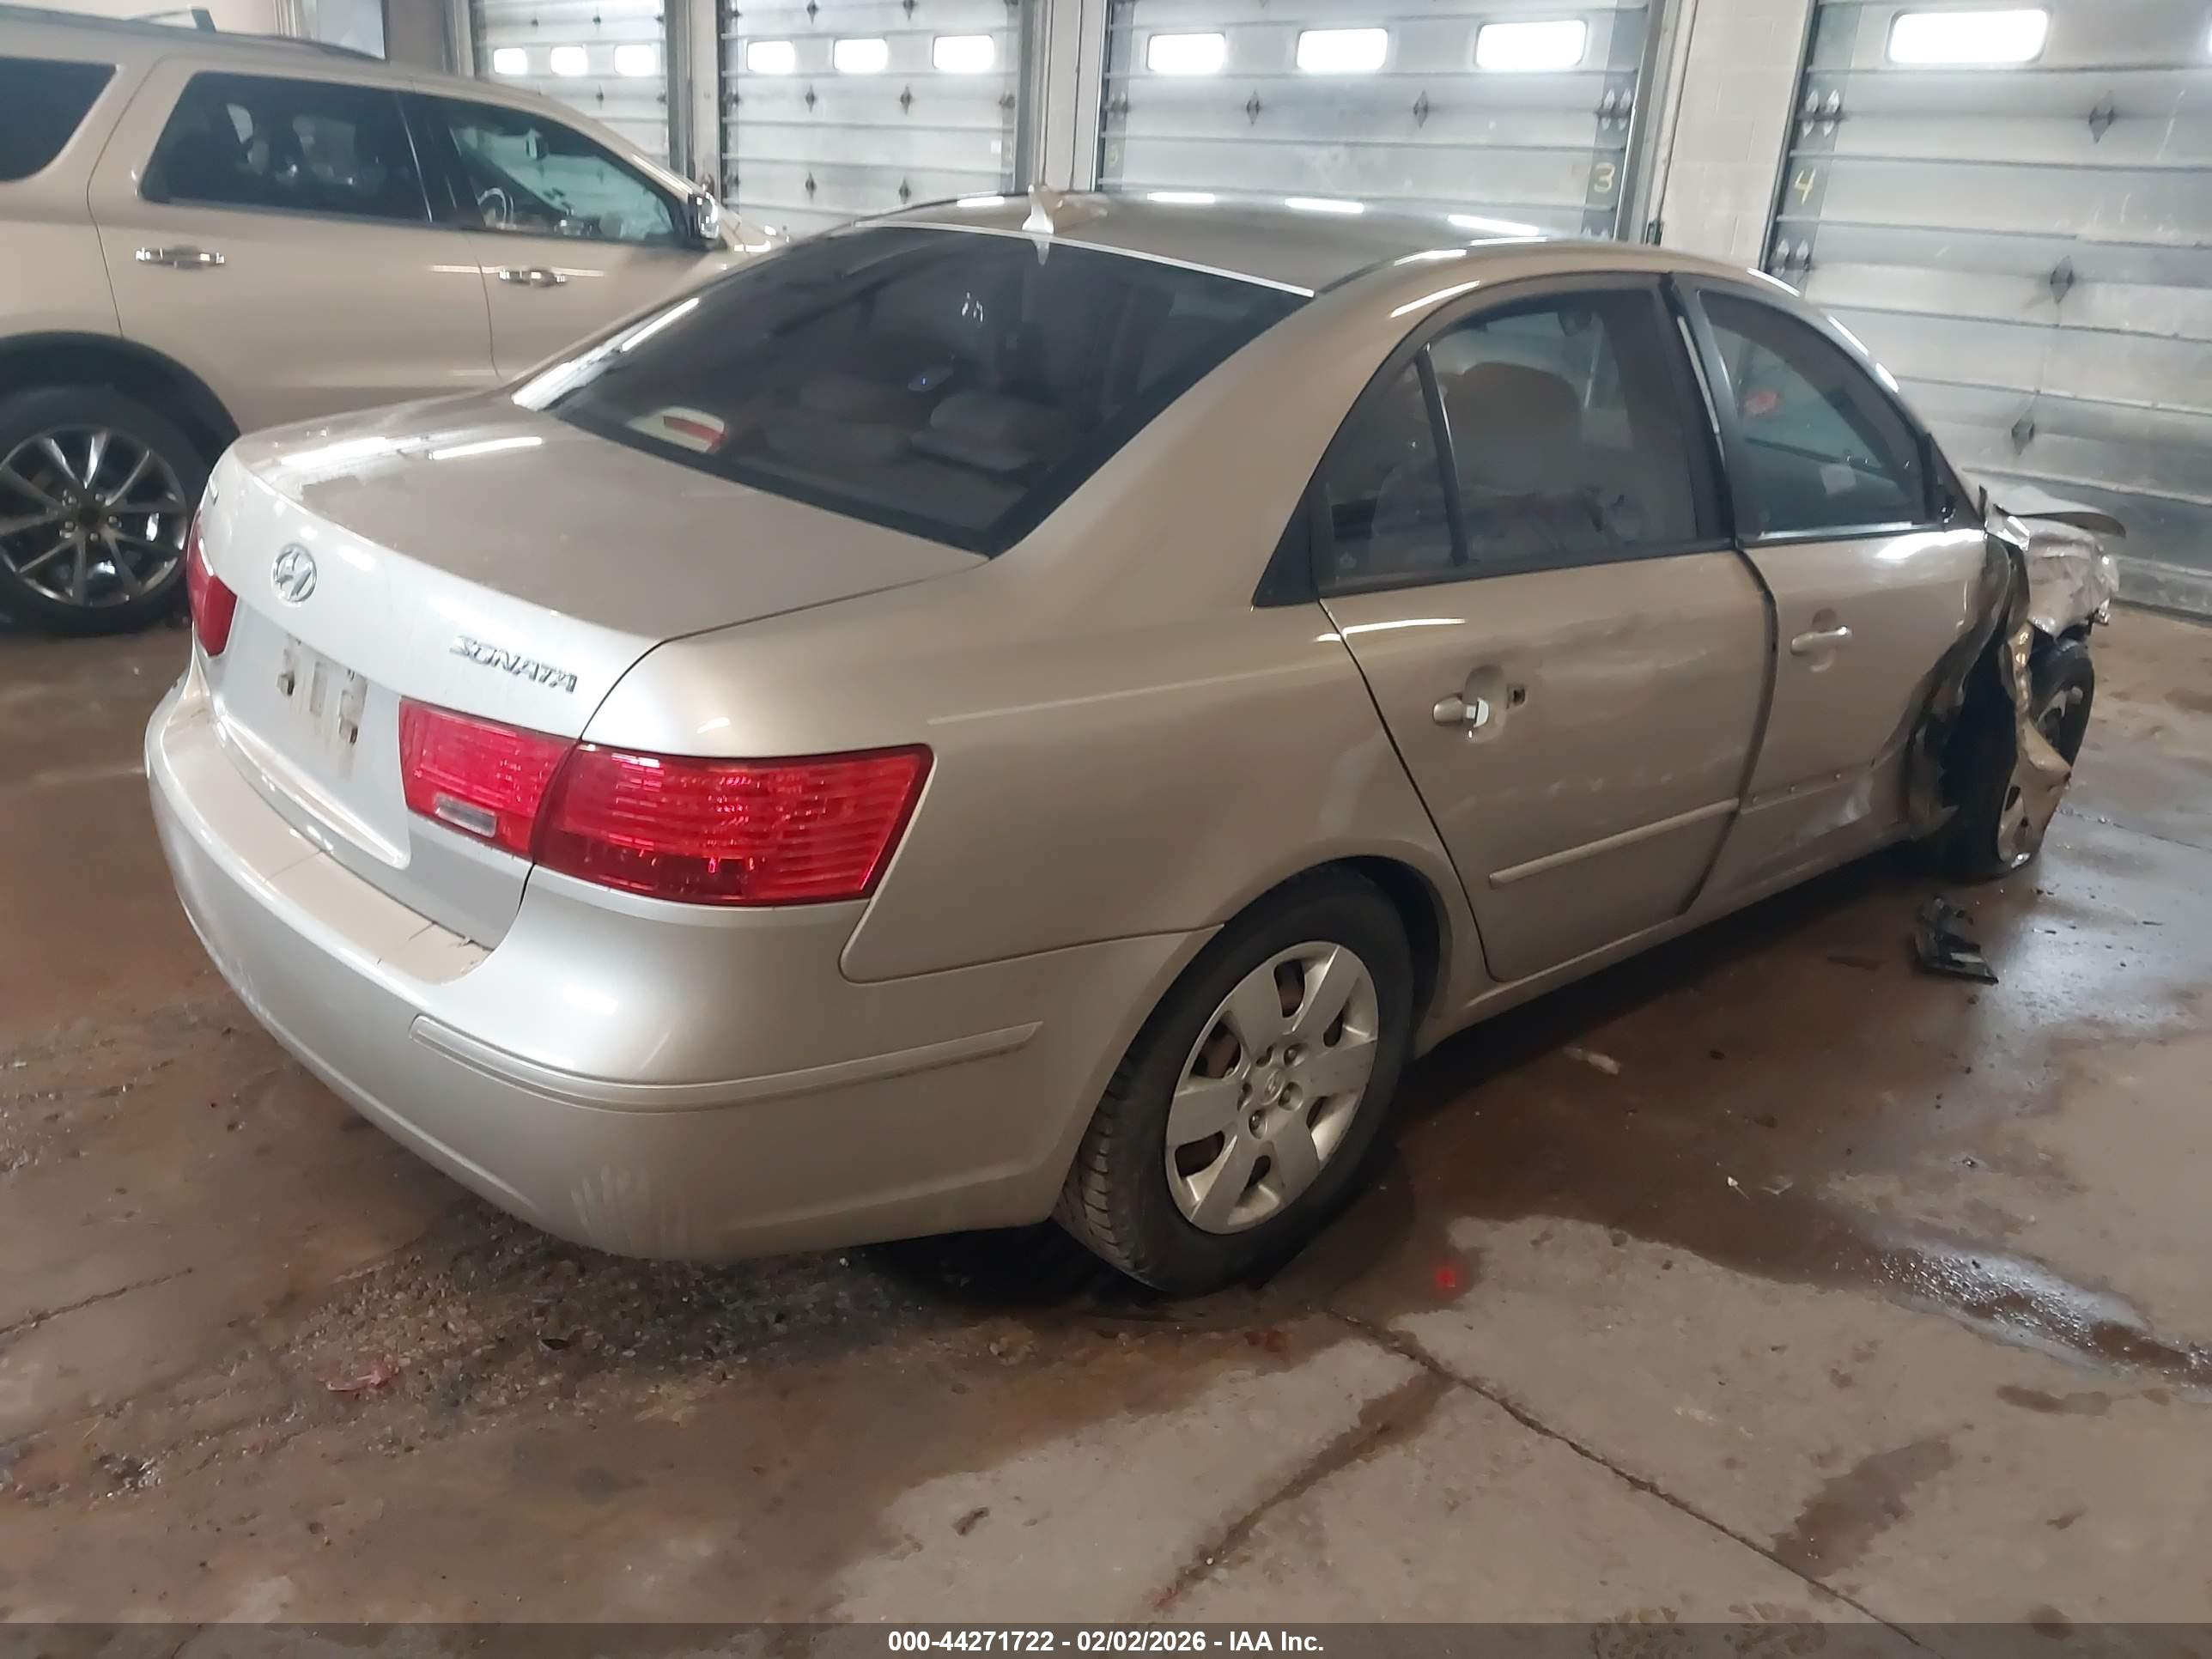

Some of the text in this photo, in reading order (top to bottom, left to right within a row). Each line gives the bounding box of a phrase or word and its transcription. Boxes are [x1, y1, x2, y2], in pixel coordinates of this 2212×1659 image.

[1594, 162, 1615, 193] 3
[1794, 167, 1816, 205] 4
[449, 635, 578, 694] SONATA
